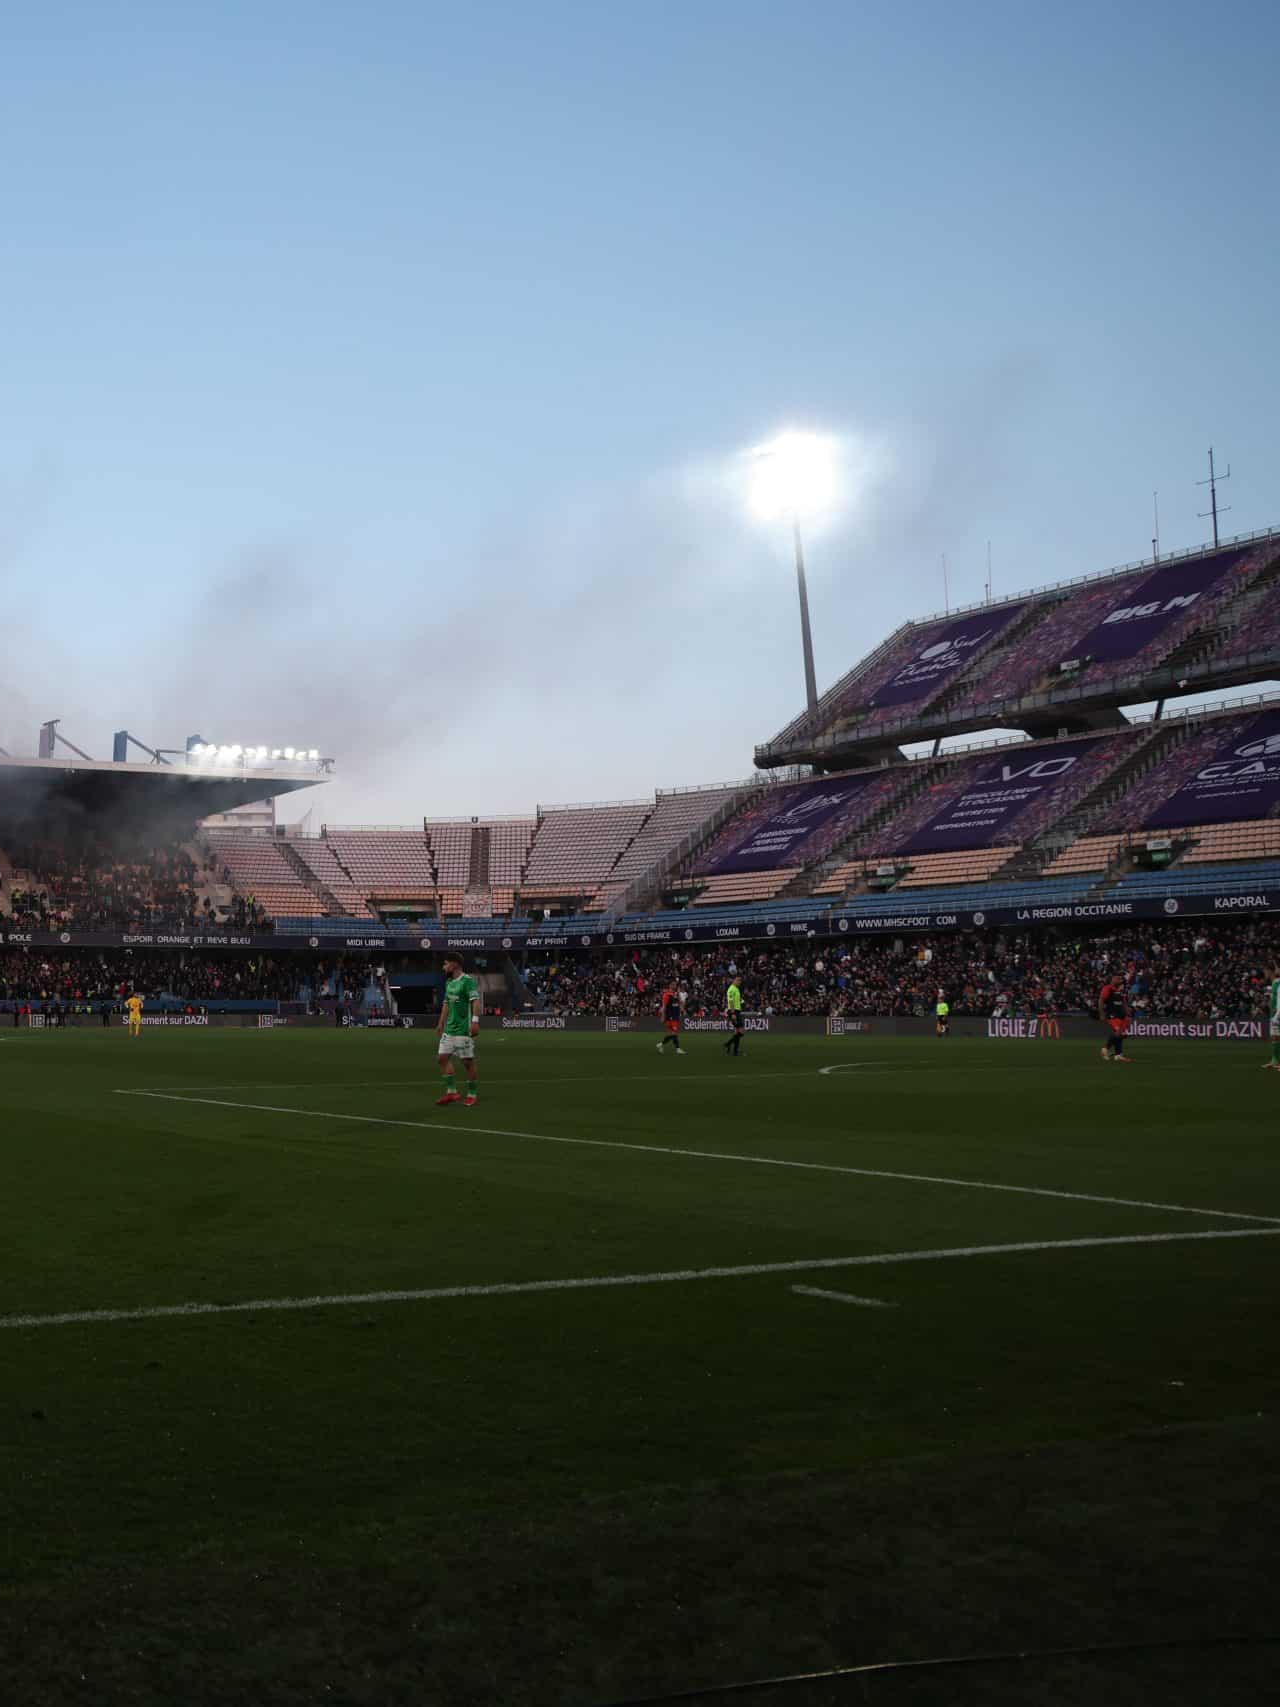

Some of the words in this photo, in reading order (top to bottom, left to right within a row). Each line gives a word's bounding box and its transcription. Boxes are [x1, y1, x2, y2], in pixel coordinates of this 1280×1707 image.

[1101, 601, 1161, 624] BIG
[1162, 592, 1202, 611] M
[1214, 896, 1270, 909] KAPORAL
[1017, 910, 1031, 920] LA
[1032, 907, 1071, 919] REGION
[1075, 904, 1133, 917] OCCITANIE
[716, 927, 739, 937] LOXAM
[123, 935, 153, 944] ESPOIR
[157, 936, 190, 944] ORANGE
[230, 936, 251, 945] BLEU
[347, 938, 363, 947] MIDI
[448, 938, 485, 948] PROMAN
[526, 938, 543, 946] ABY
[545, 937, 568, 945] PRINT
[169, 1017, 185, 1026] sur
[185, 1015, 208, 1025] DAZN
[502, 1017, 535, 1029] Seulement
[546, 1017, 565, 1028] DAZN
[684, 1018, 728, 1031] Seulement
[744, 1019, 769, 1031] DAZN
[988, 1018, 1026, 1038] LIGUE
[1188, 1023, 1213, 1038] sur
[1216, 1020, 1262, 1038] DAZN
